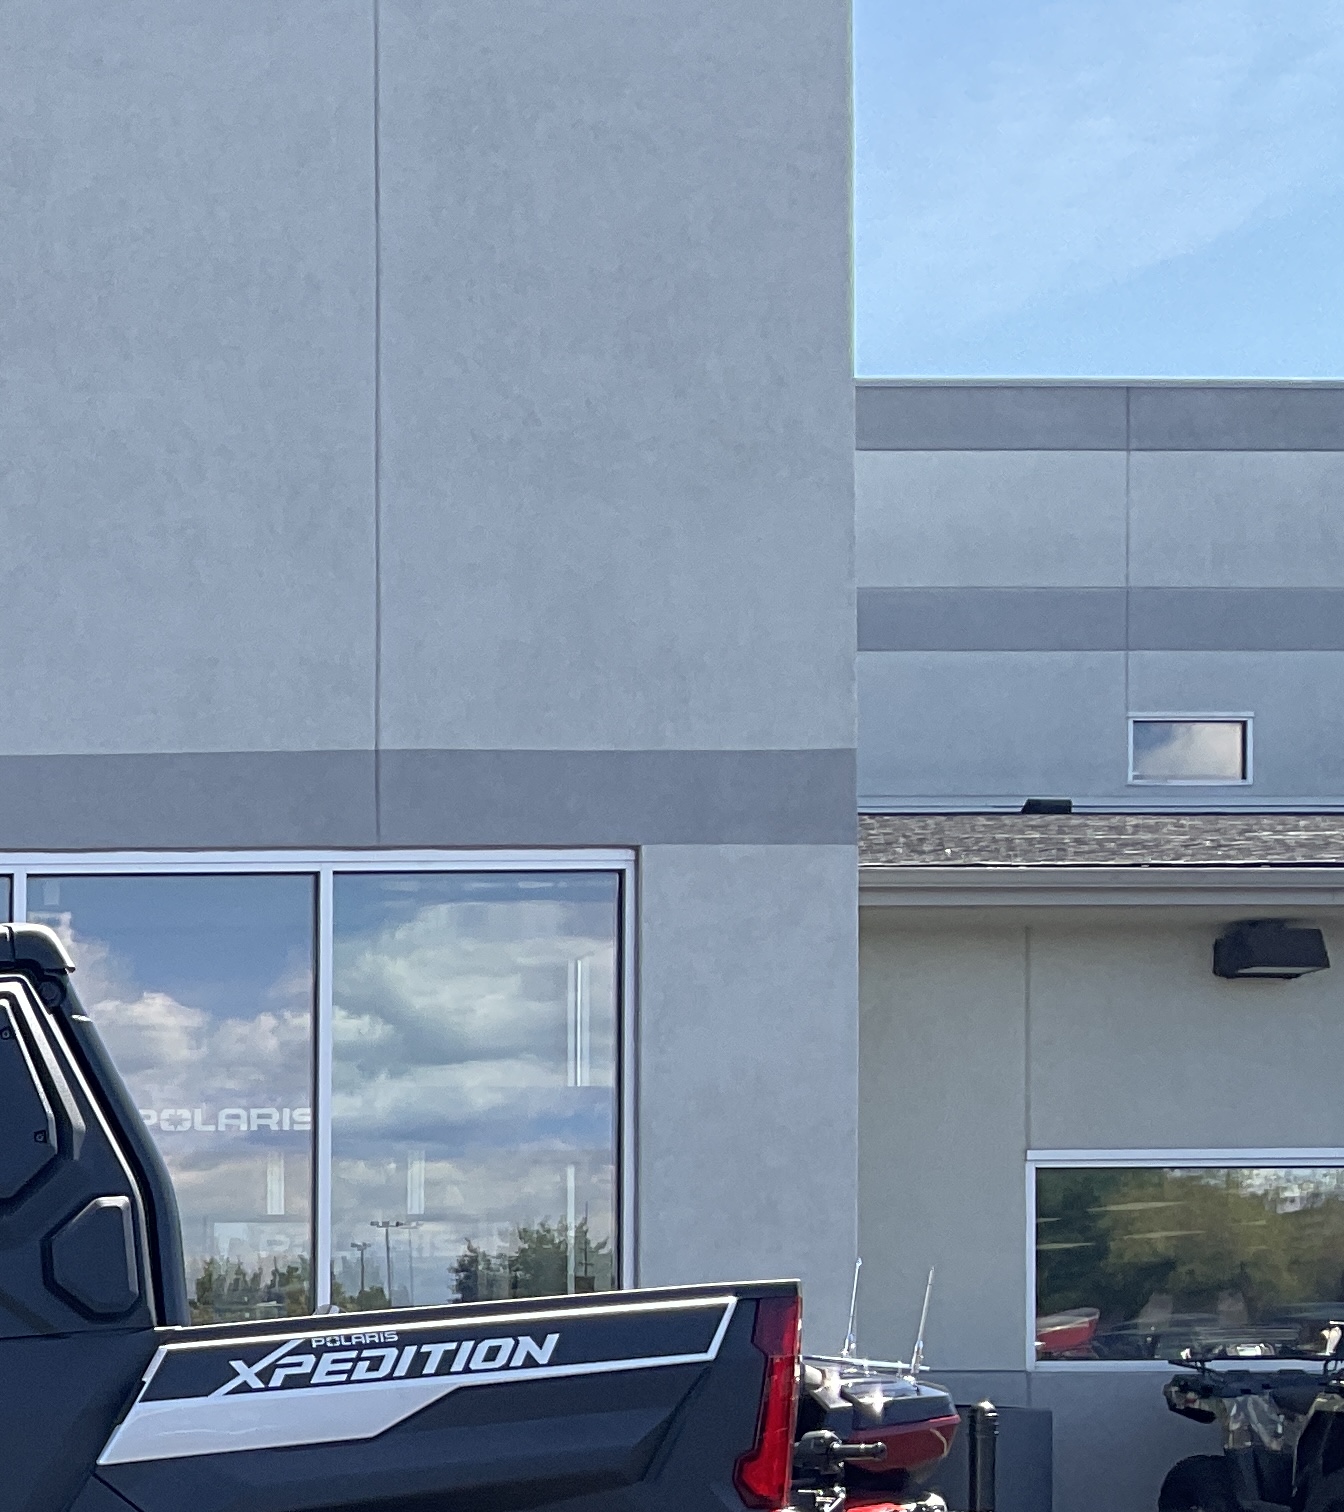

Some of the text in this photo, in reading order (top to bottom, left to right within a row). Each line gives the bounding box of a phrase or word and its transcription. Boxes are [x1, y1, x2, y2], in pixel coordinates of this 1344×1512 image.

[138, 1107, 311, 1132] POLARIS
[311, 1330, 399, 1348] POLARIS
[207, 1333, 560, 1396] XPEDITION
